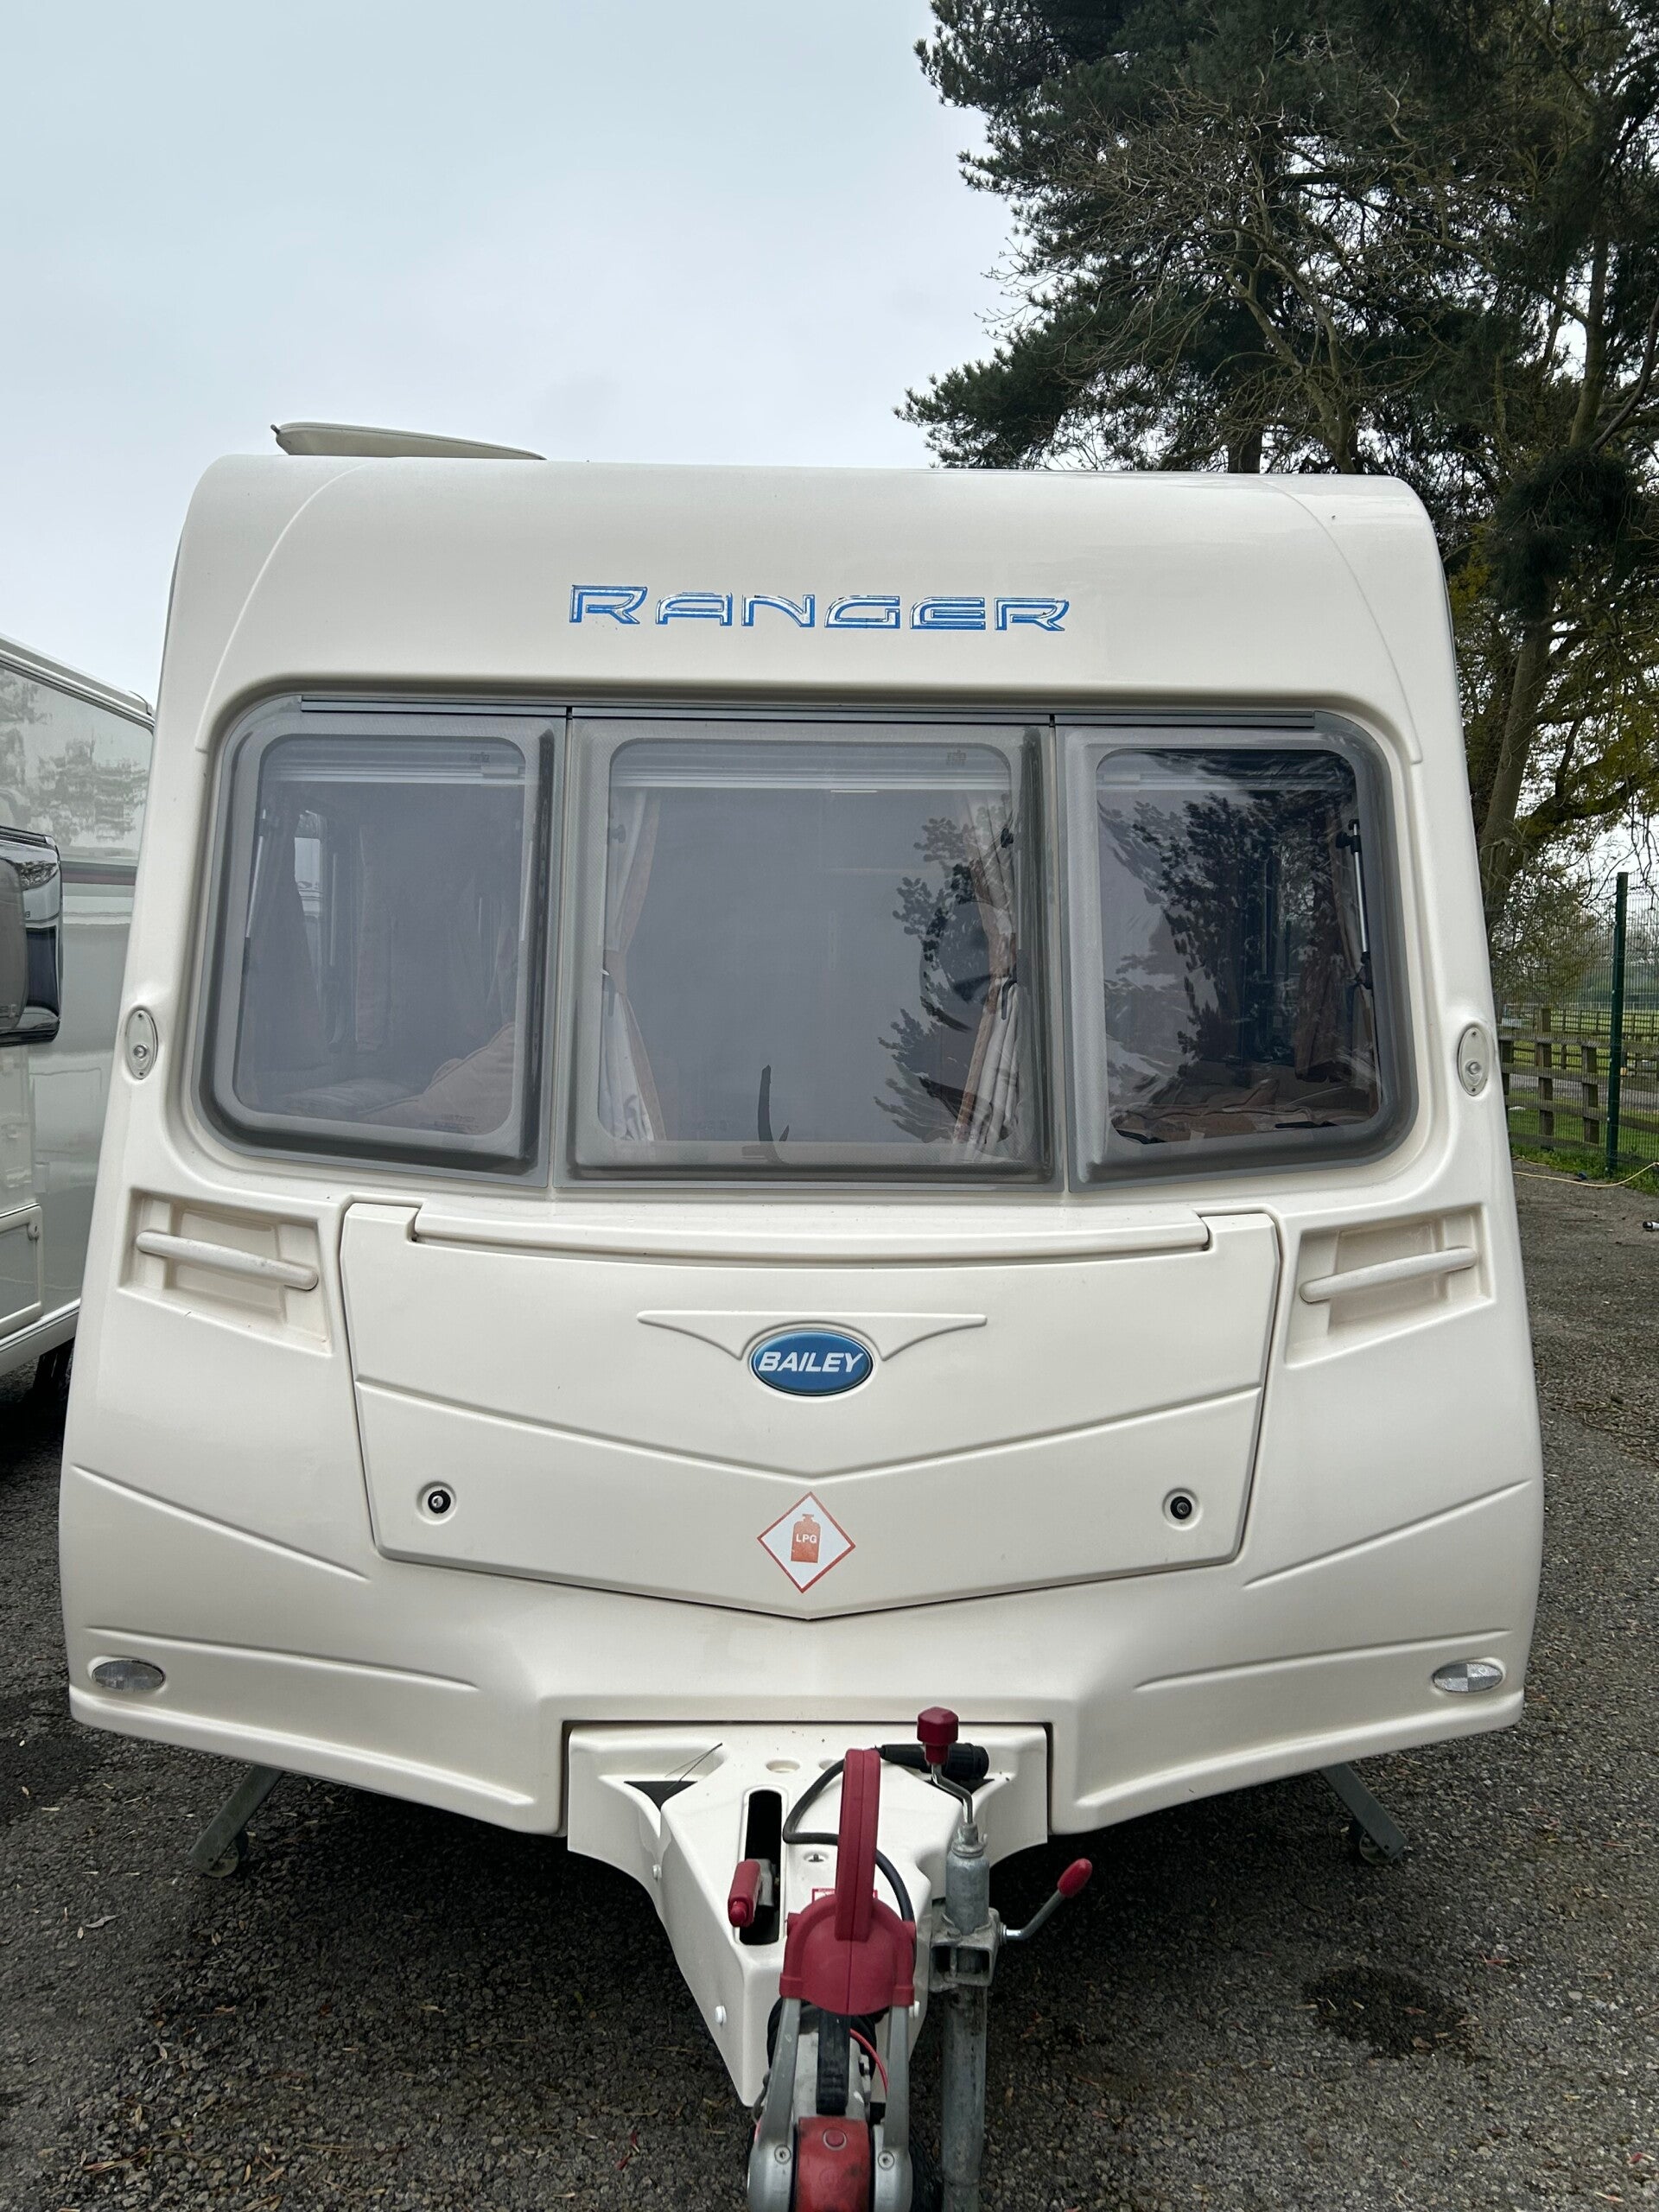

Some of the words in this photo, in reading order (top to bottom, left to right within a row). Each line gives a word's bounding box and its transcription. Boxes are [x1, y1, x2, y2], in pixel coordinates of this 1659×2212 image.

[569, 584, 1070, 632] RANGER
[758, 1351, 863, 1373] BAILEY
[796, 1534, 817, 1543] LPG
